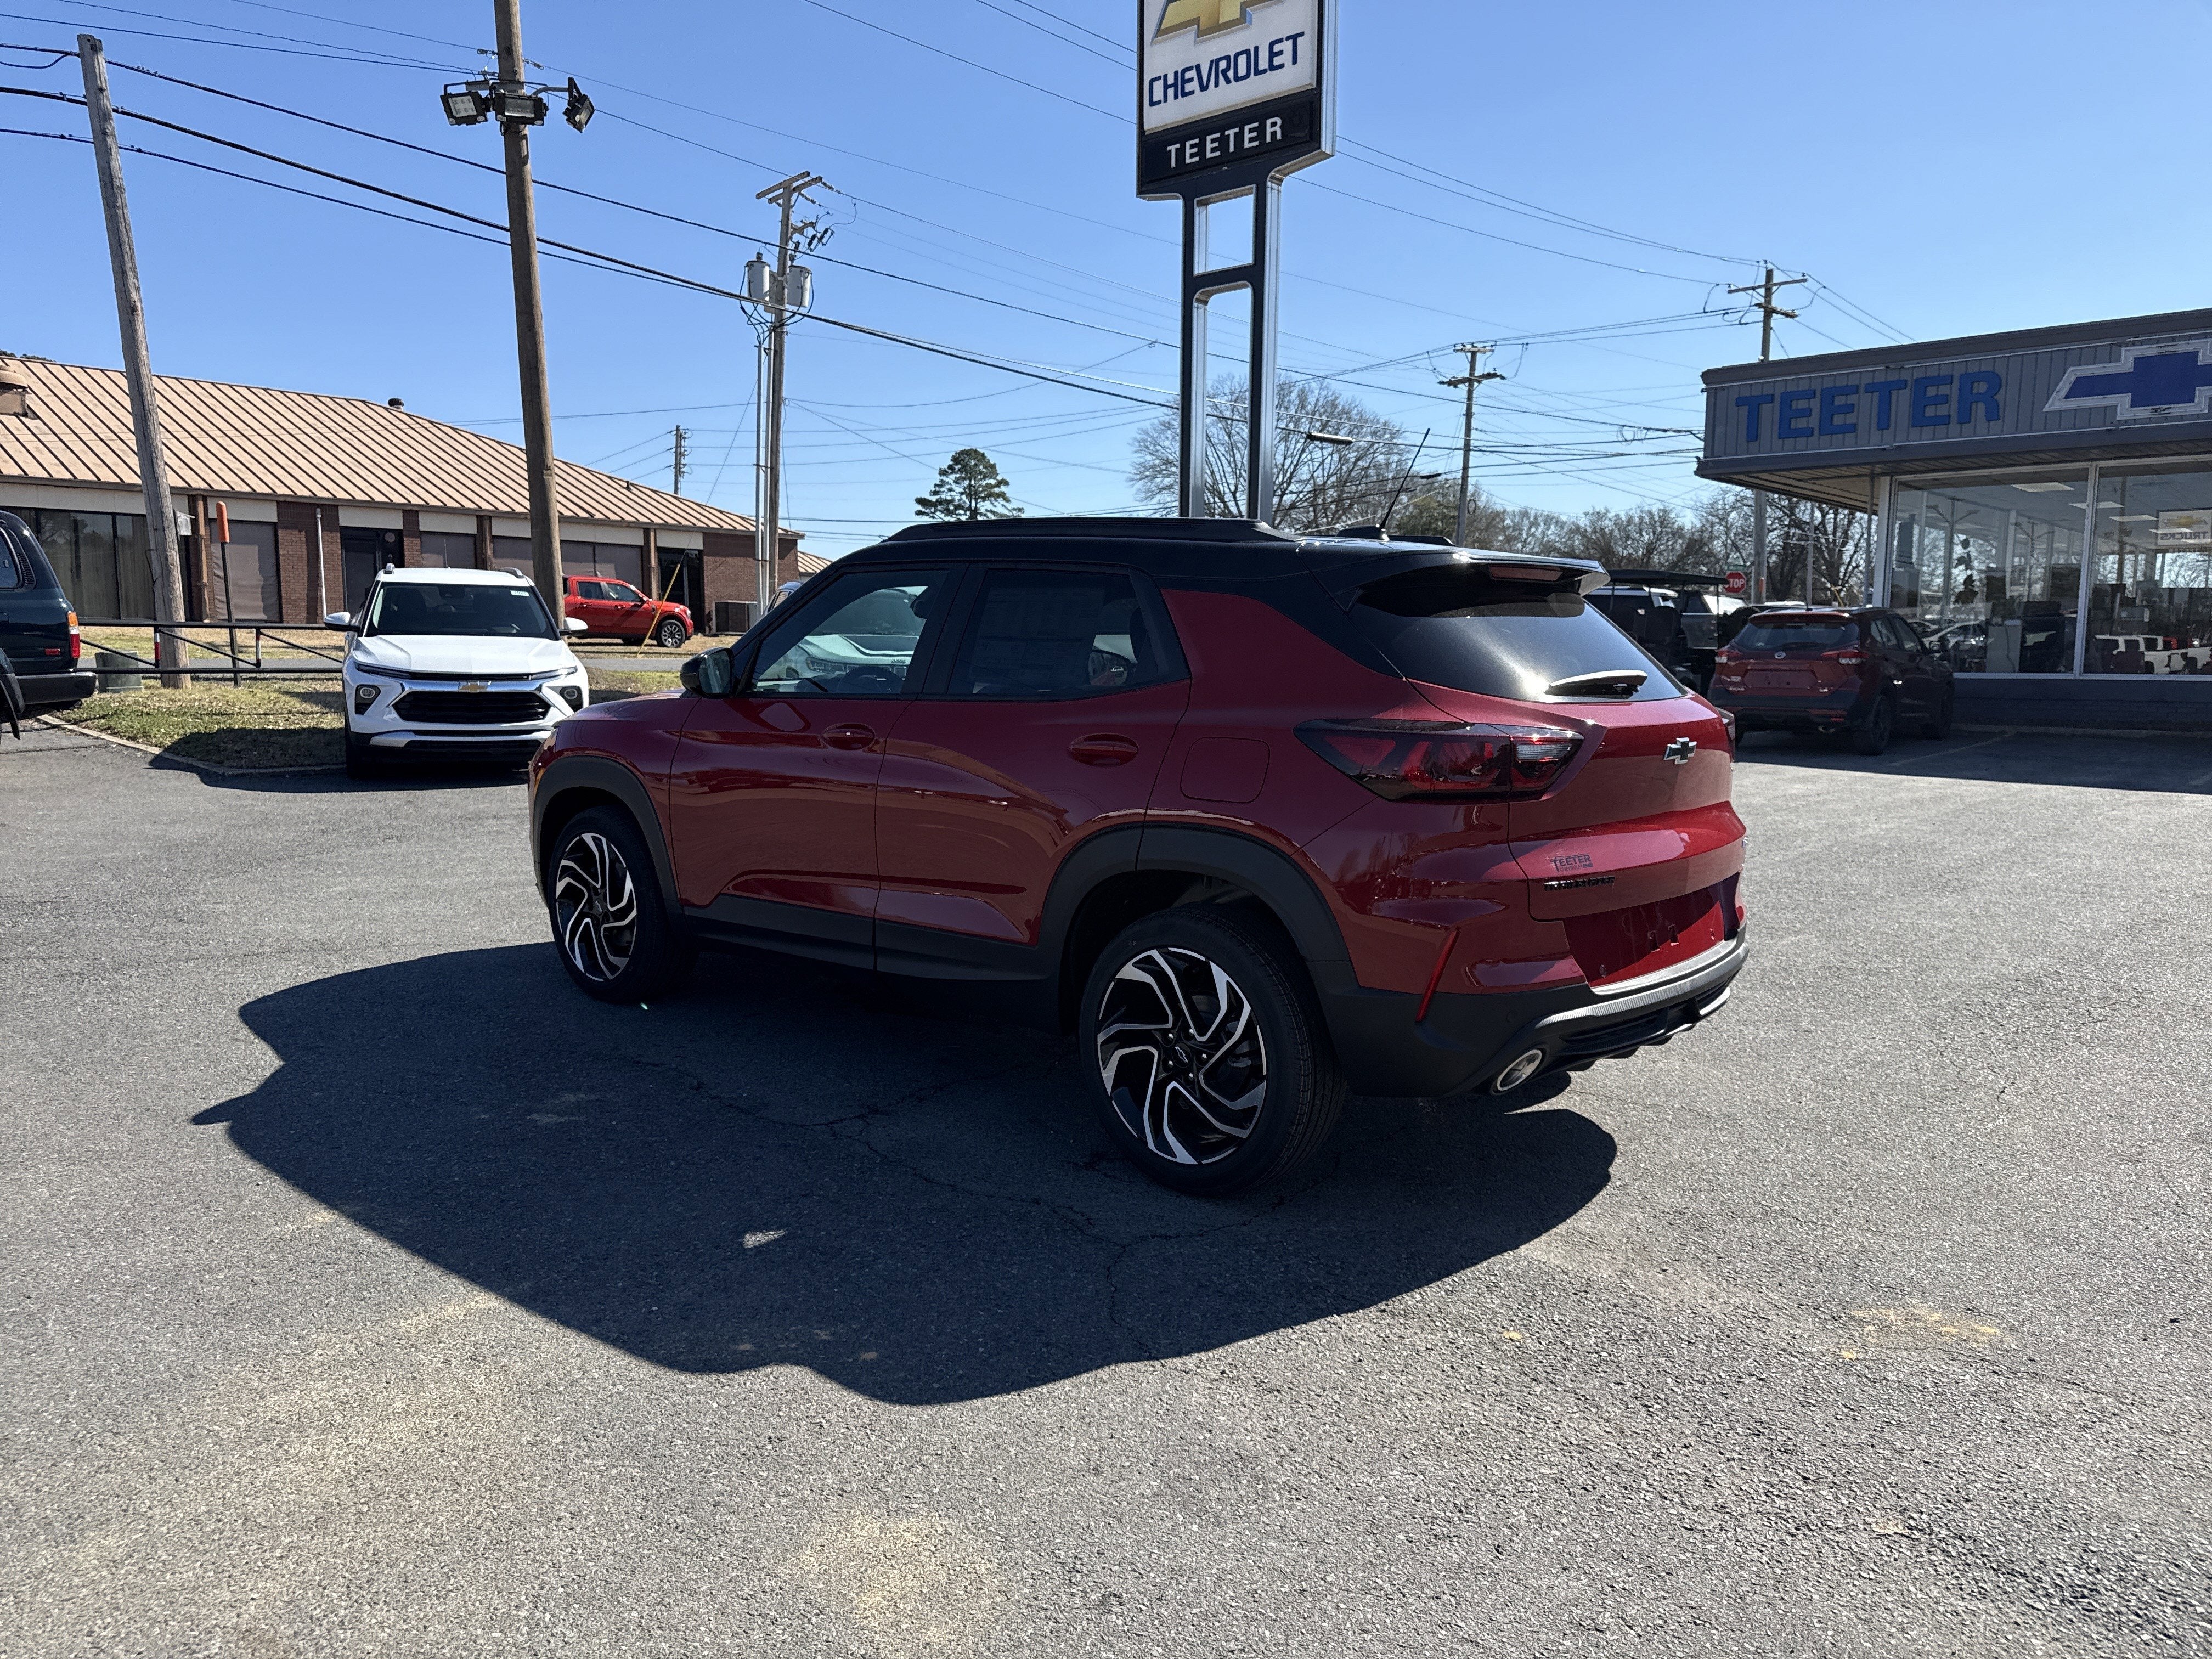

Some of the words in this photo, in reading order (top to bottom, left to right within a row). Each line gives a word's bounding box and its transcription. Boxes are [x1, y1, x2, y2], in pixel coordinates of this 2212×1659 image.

[1148, 31, 1305, 107] CHEVROLET
[1166, 117, 1282, 168] TEETER
[1735, 370, 2002, 442] TEETER
[1550, 854, 1592, 872] TEETER
